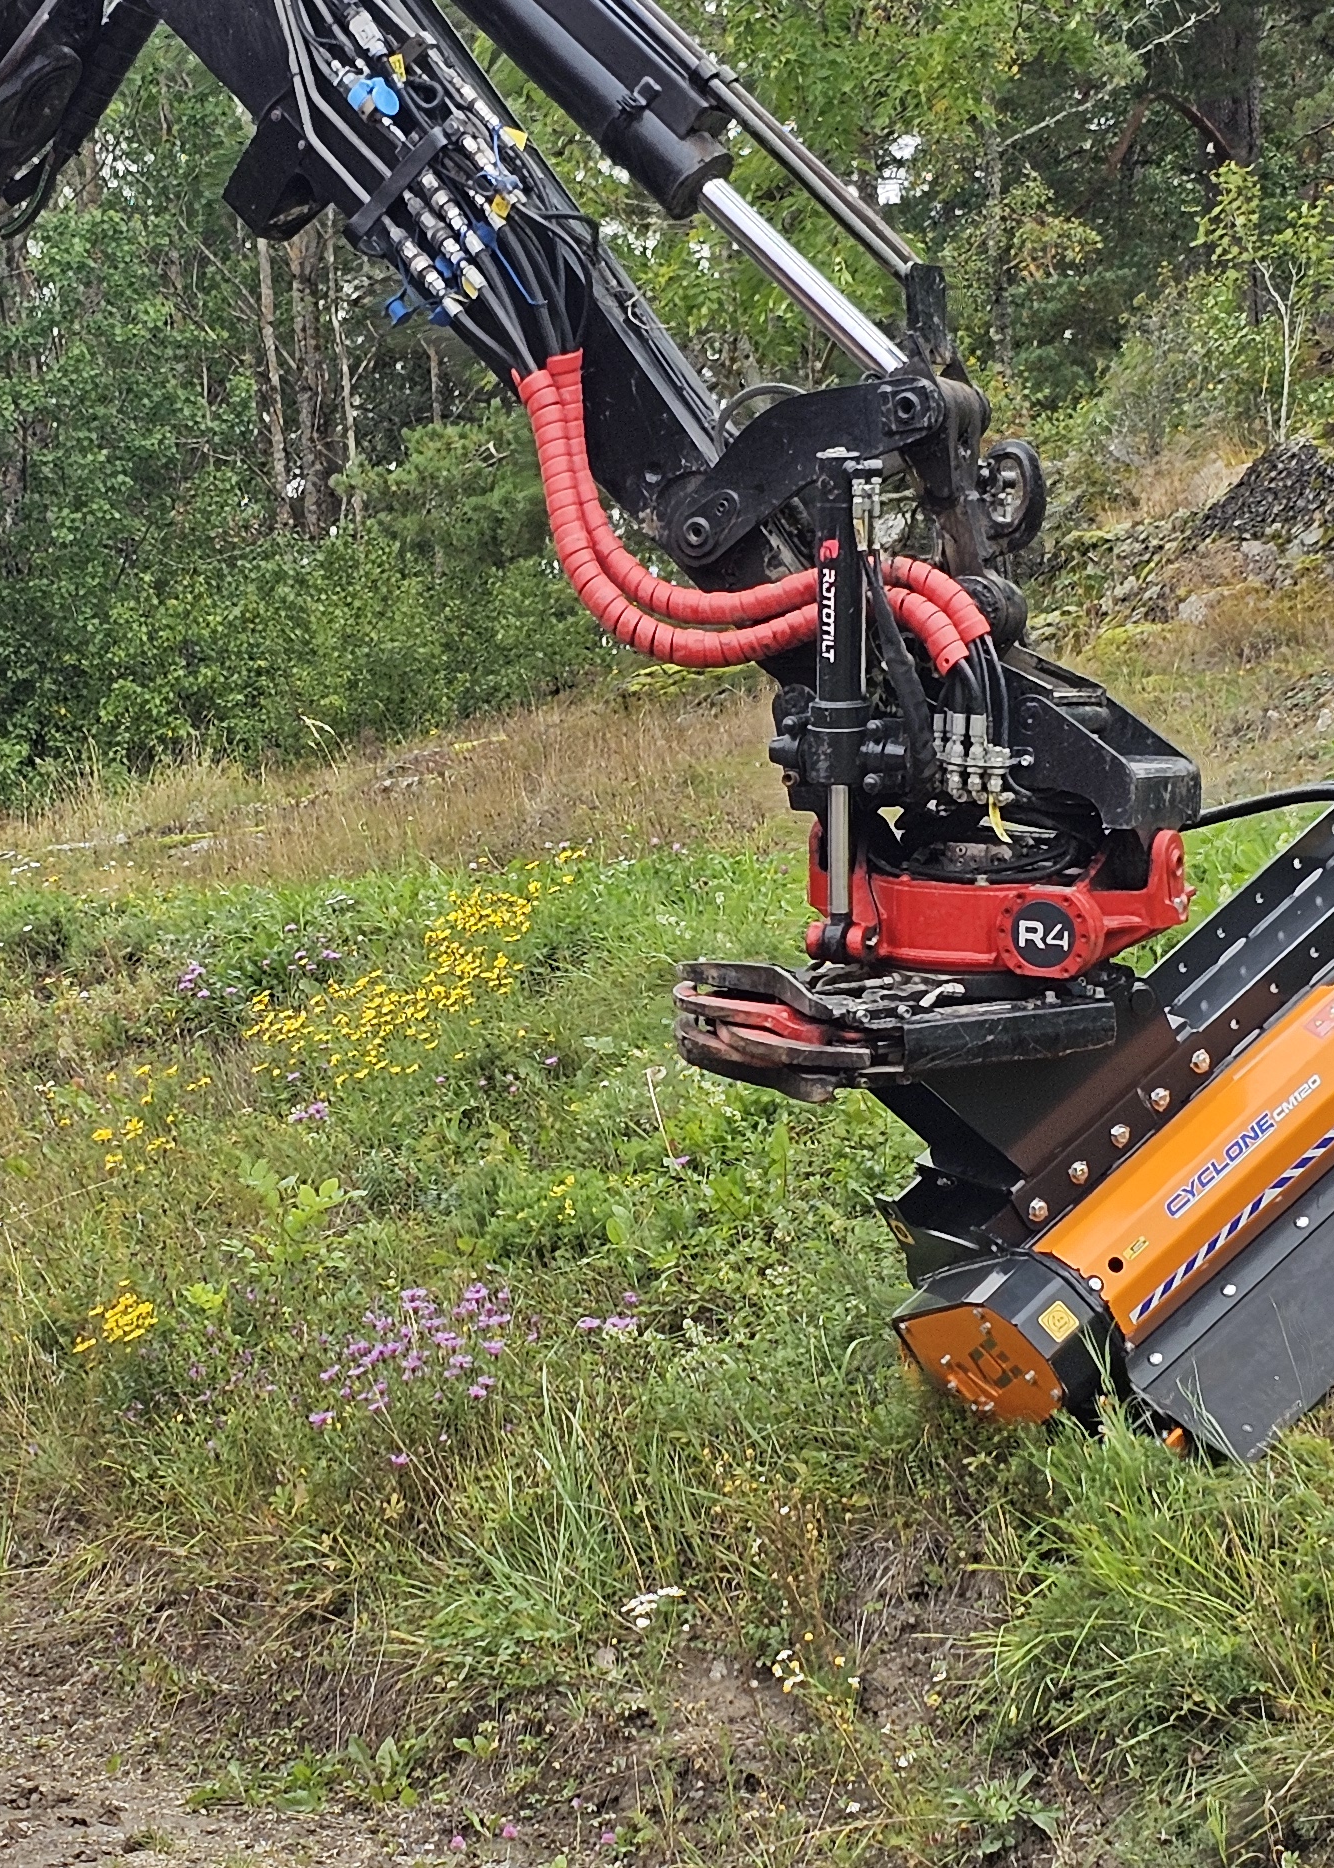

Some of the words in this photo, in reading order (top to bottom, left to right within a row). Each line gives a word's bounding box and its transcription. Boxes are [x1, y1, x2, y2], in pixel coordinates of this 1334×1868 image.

[1018, 919, 1069, 952] R4
[1165, 1111, 1277, 1218] CYCLONE
[1272, 1074, 1322, 1122] CM120
